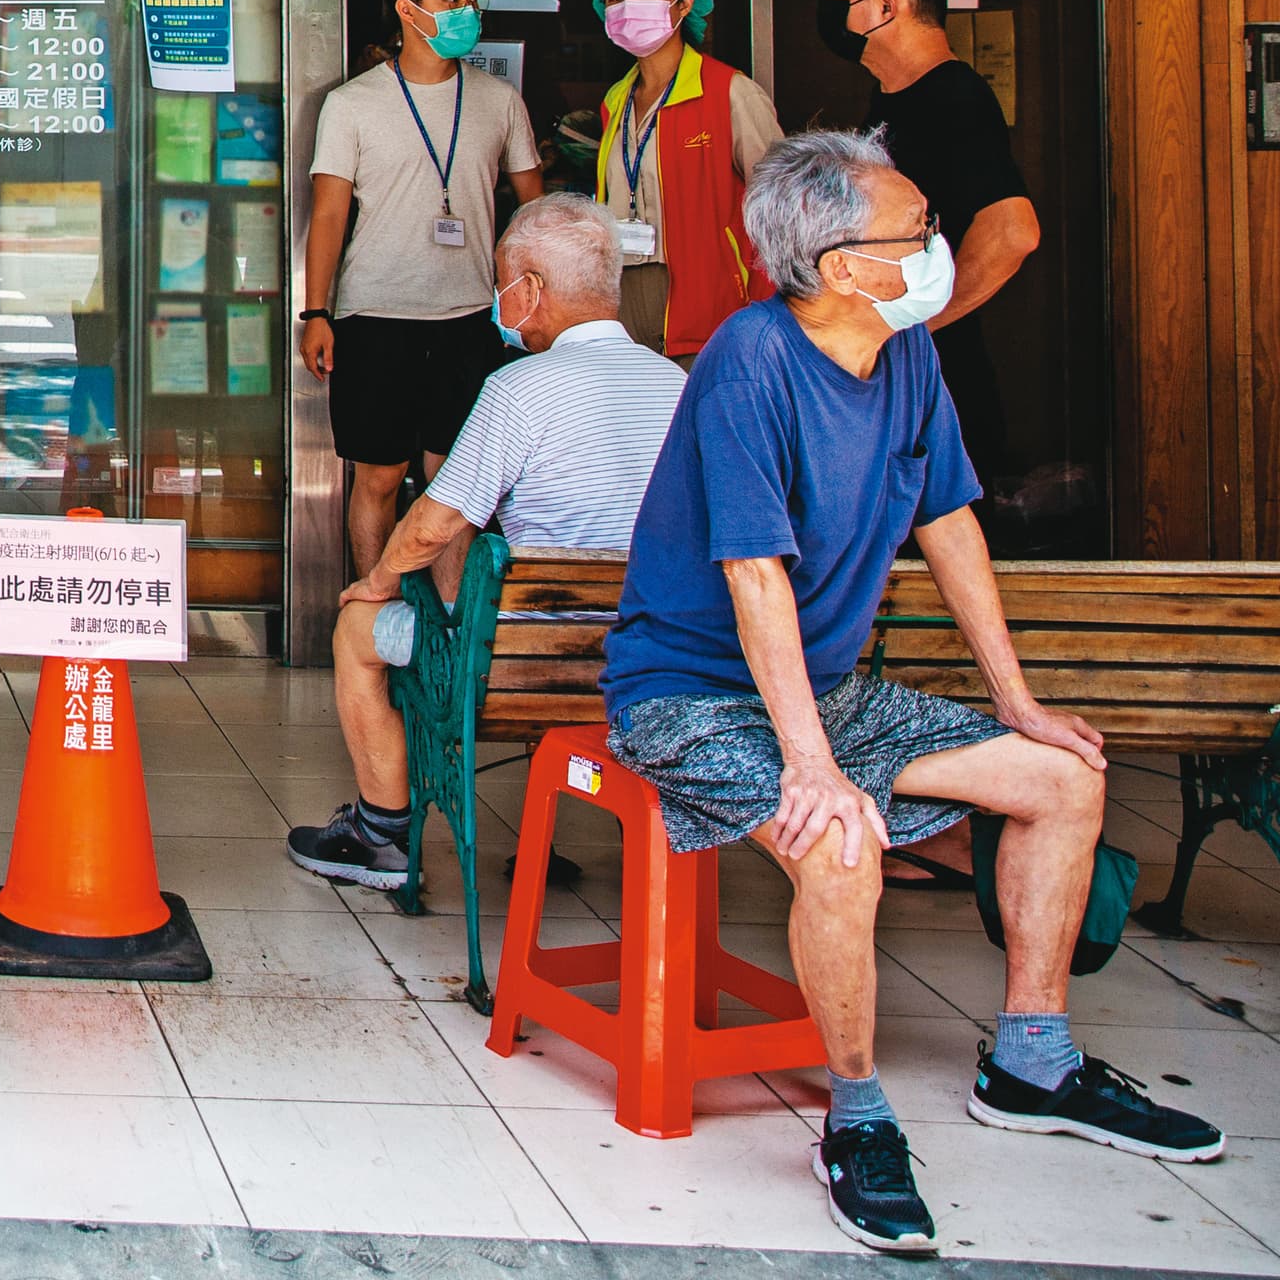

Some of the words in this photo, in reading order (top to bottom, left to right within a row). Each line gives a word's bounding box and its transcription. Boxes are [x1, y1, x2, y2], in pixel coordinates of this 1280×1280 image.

[0, 574, 173, 607] 此處請勿停車
[70, 616, 168, 636] 謝謝您的配合
[63, 663, 89, 751] 辦公處
[90, 665, 115, 751] 金龍里
